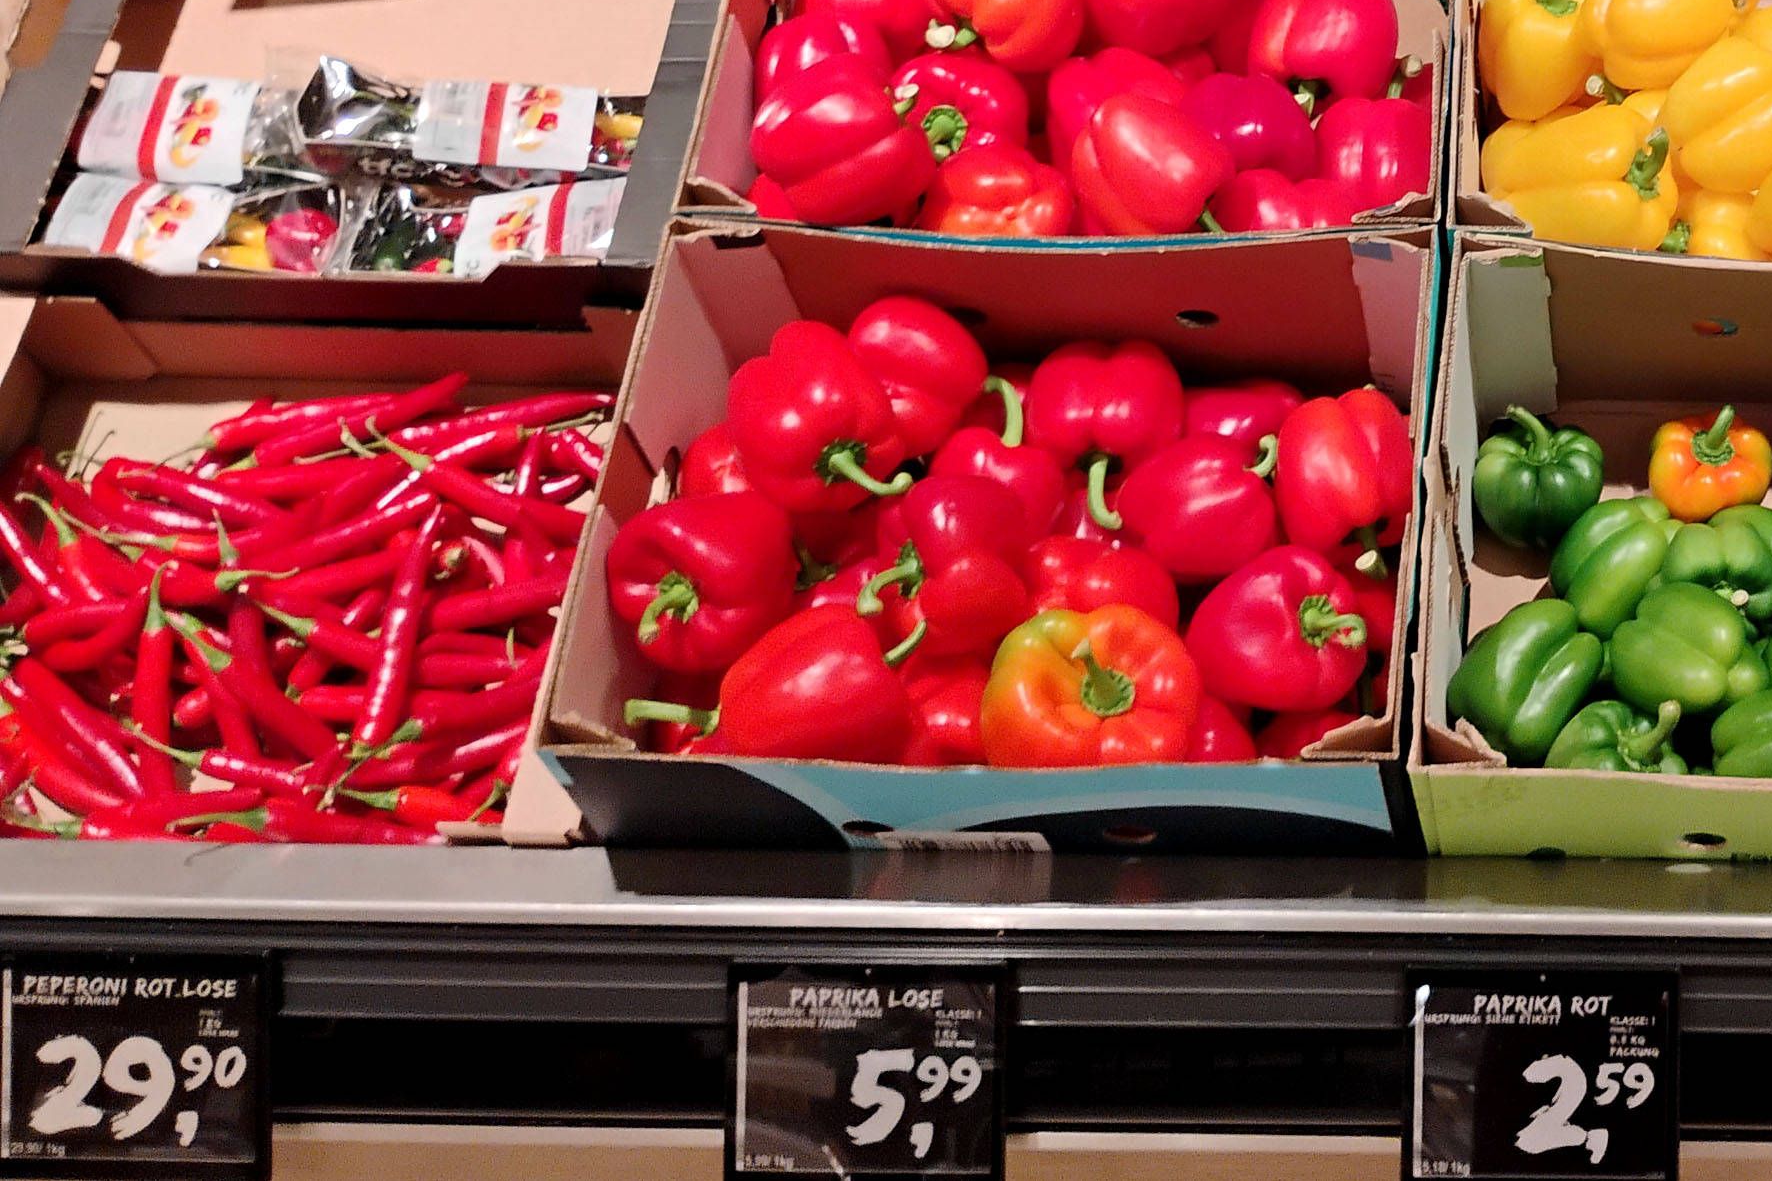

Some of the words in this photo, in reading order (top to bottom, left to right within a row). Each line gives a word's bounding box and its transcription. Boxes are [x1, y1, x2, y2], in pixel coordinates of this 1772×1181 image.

[23, 975, 128, 996] PEPERONI
[134, 977, 177, 998] ROT
[182, 979, 238, 998] LOSE
[789, 987, 880, 1008] PAPRIKA
[887, 988, 945, 1009] LOSE
[1473, 993, 1562, 1015] PAPRIKA
[1570, 995, 1613, 1017] ROT
